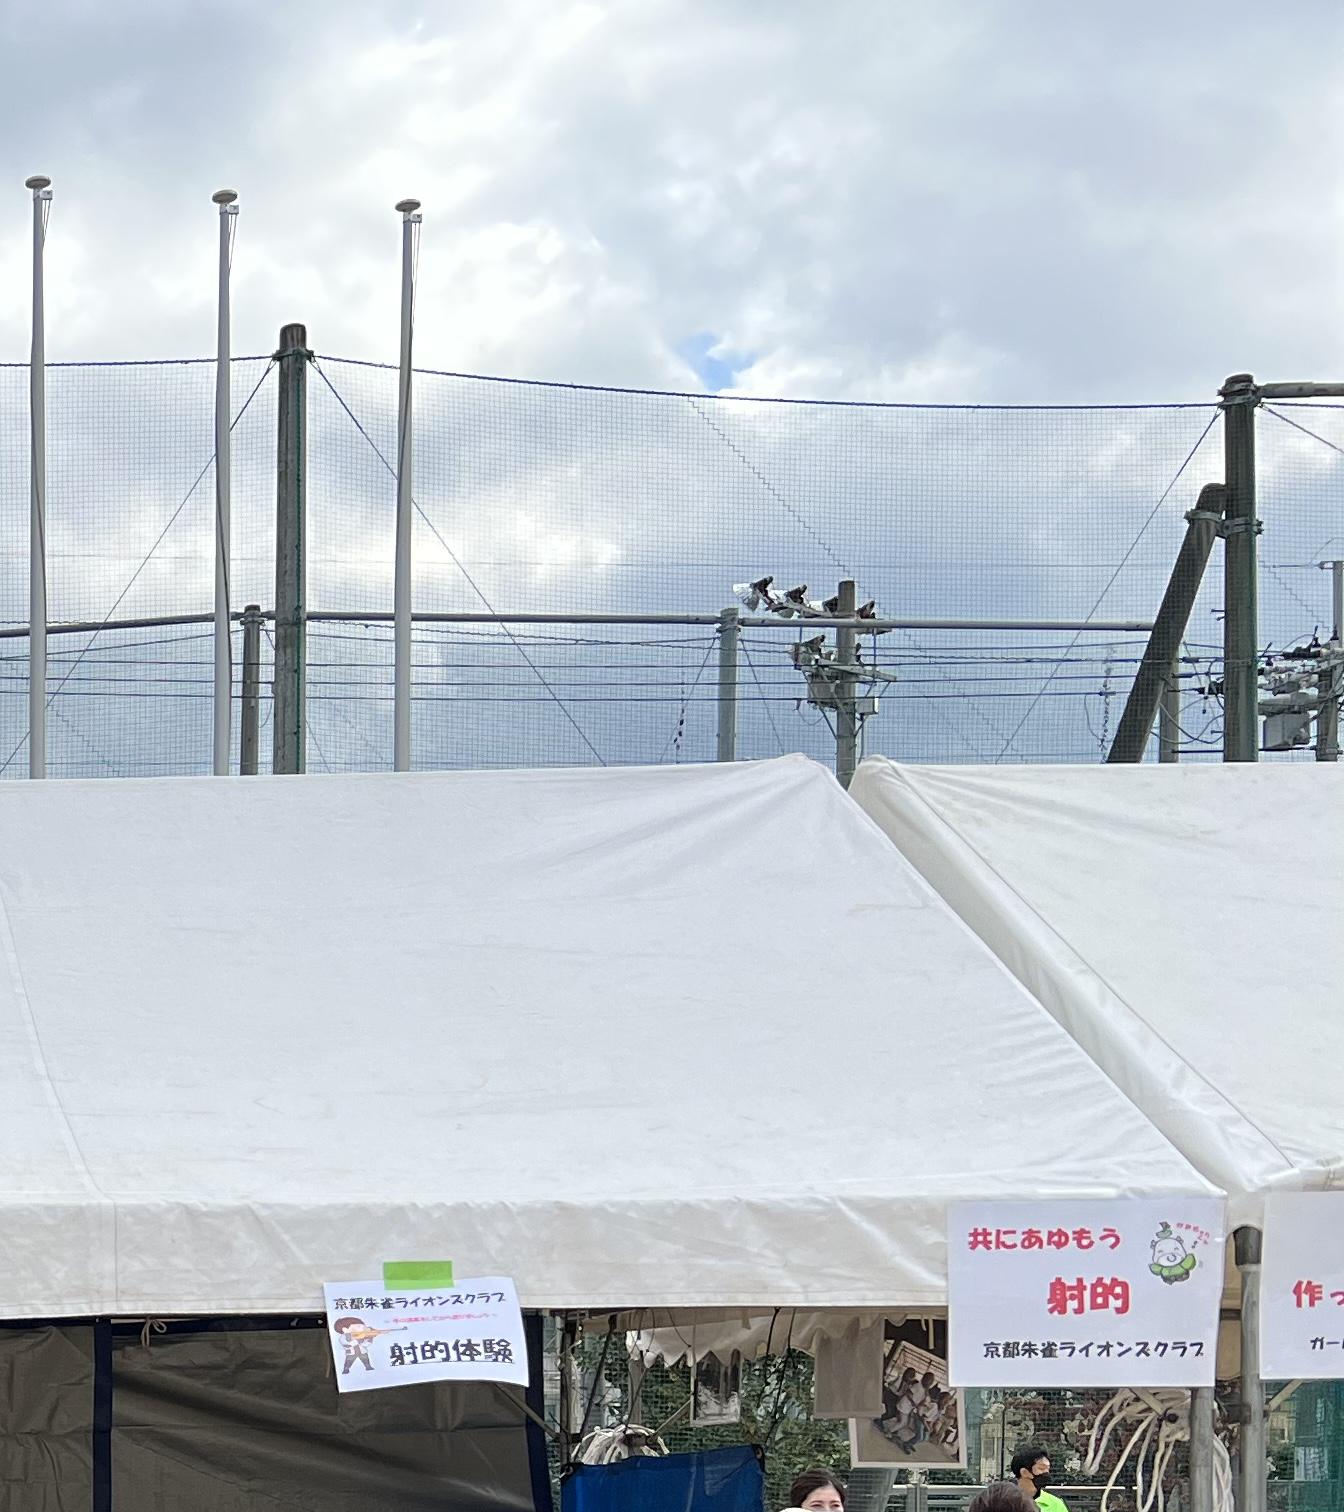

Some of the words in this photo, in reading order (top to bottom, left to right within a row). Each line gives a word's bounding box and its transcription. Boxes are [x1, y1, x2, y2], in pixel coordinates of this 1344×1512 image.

[967, 1227, 1122, 1251] 共にあゆもう
[1047, 1276, 1131, 1316] 射的
[389, 1338, 514, 1367] 射的体験
[983, 1341, 1205, 1359] 京都朱雀ライオンズクラブ
[1310, 1336, 1344, 1350] ガー
